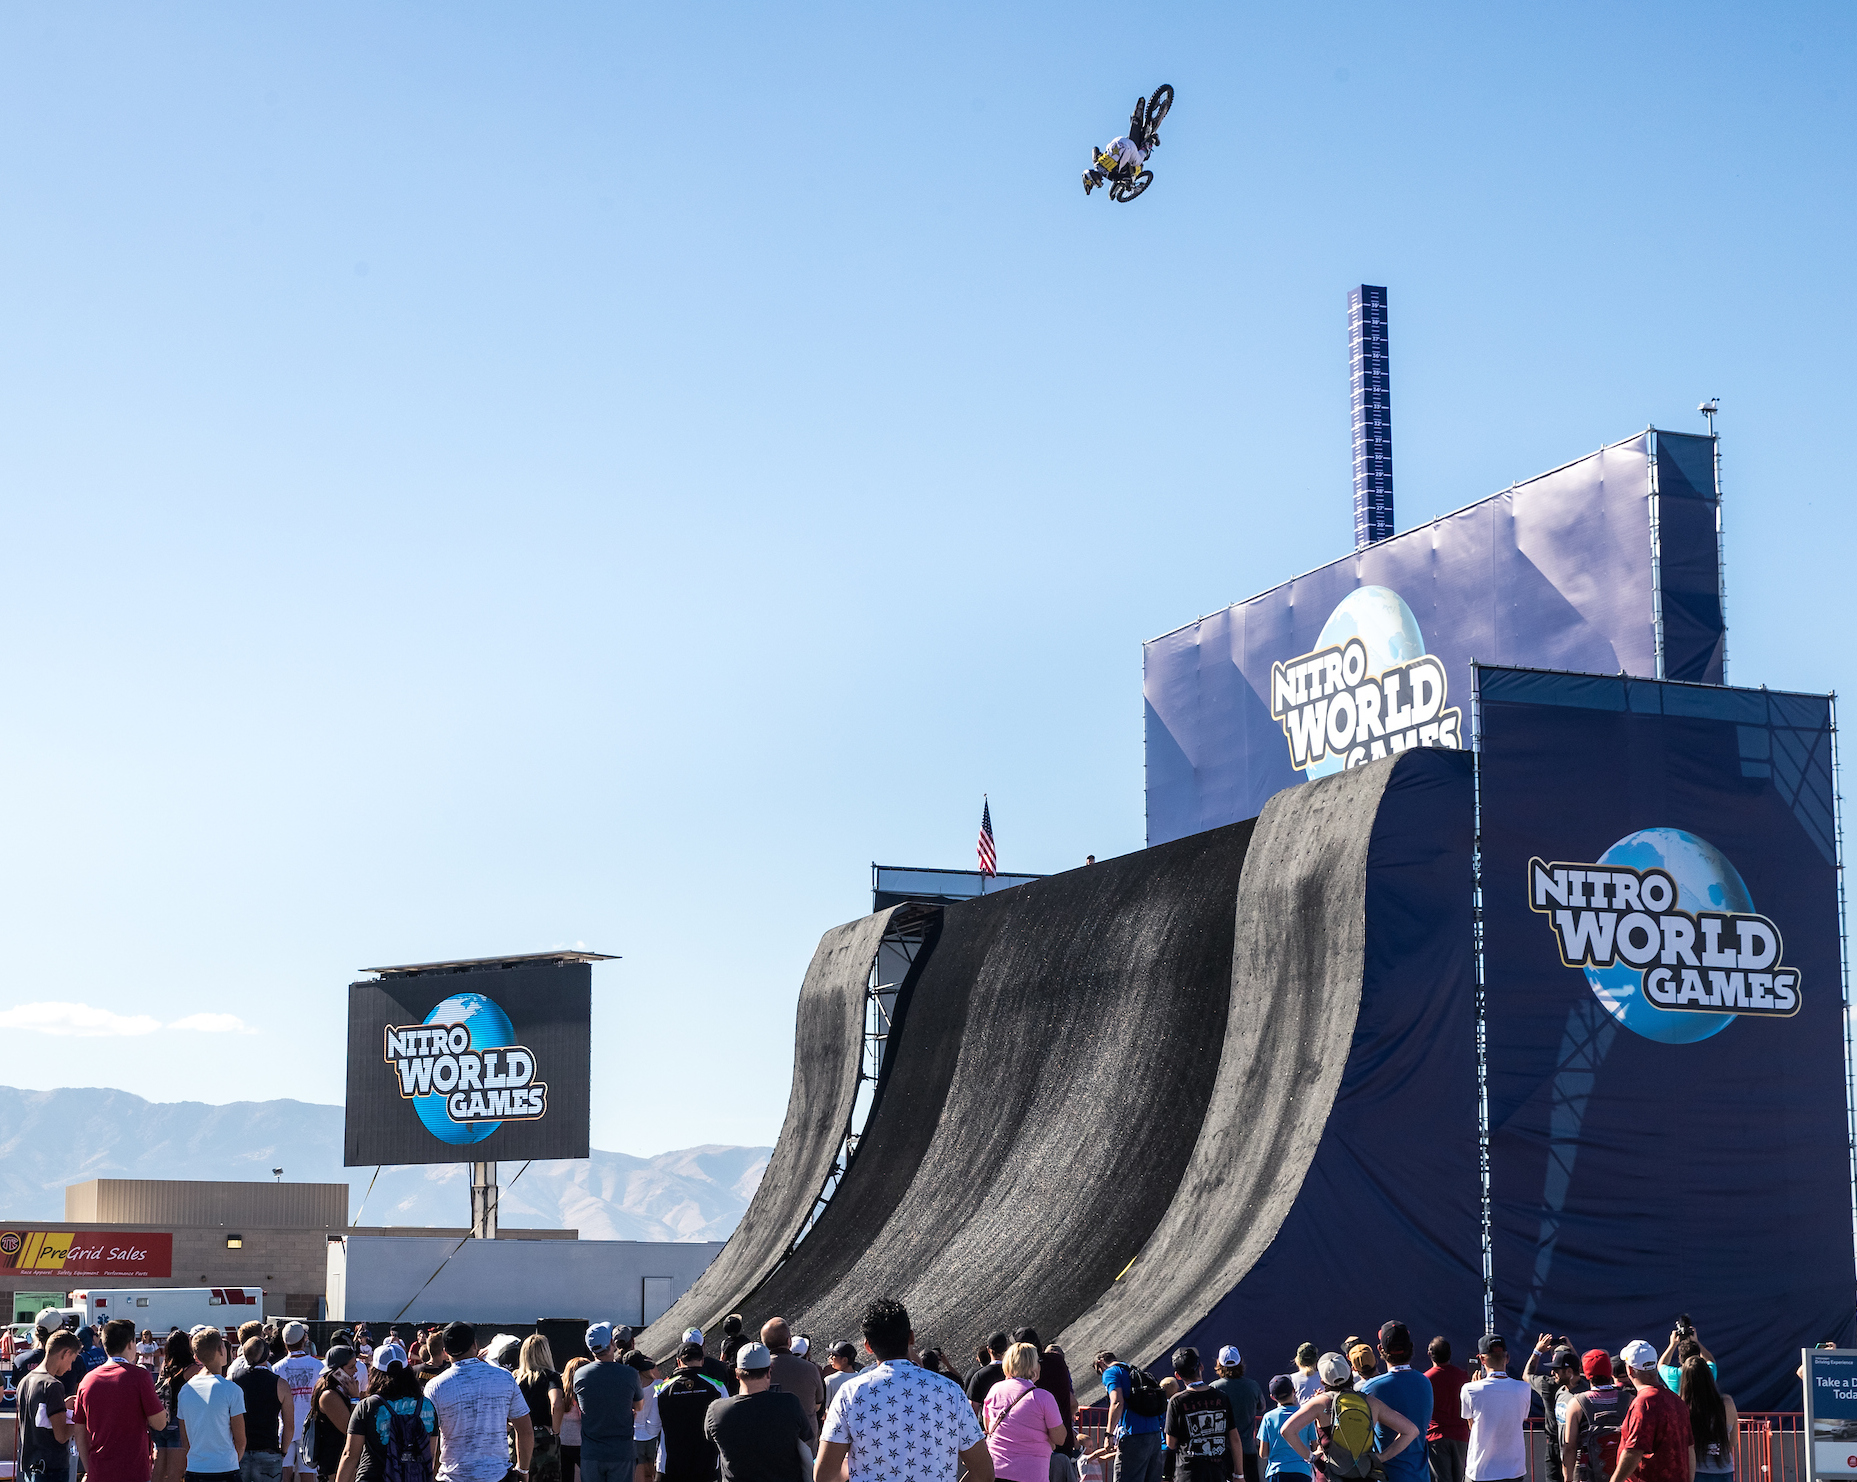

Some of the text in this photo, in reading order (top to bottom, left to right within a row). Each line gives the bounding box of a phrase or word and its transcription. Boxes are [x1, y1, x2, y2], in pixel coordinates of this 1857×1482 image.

[1275, 643, 1364, 712] NITRO
[1287, 663, 1442, 763] WORLD
[1535, 865, 1673, 913] NITRO
[1556, 910, 1777, 970] WORLD
[1647, 967, 1796, 1010] GAMES
[387, 1026, 469, 1058] NITRO
[398, 1051, 533, 1094] WORLD
[449, 1088, 544, 1118] GAMES
[40, 1246, 147, 1261] PreGrid Sales
[1816, 1377, 1840, 1387] Take
